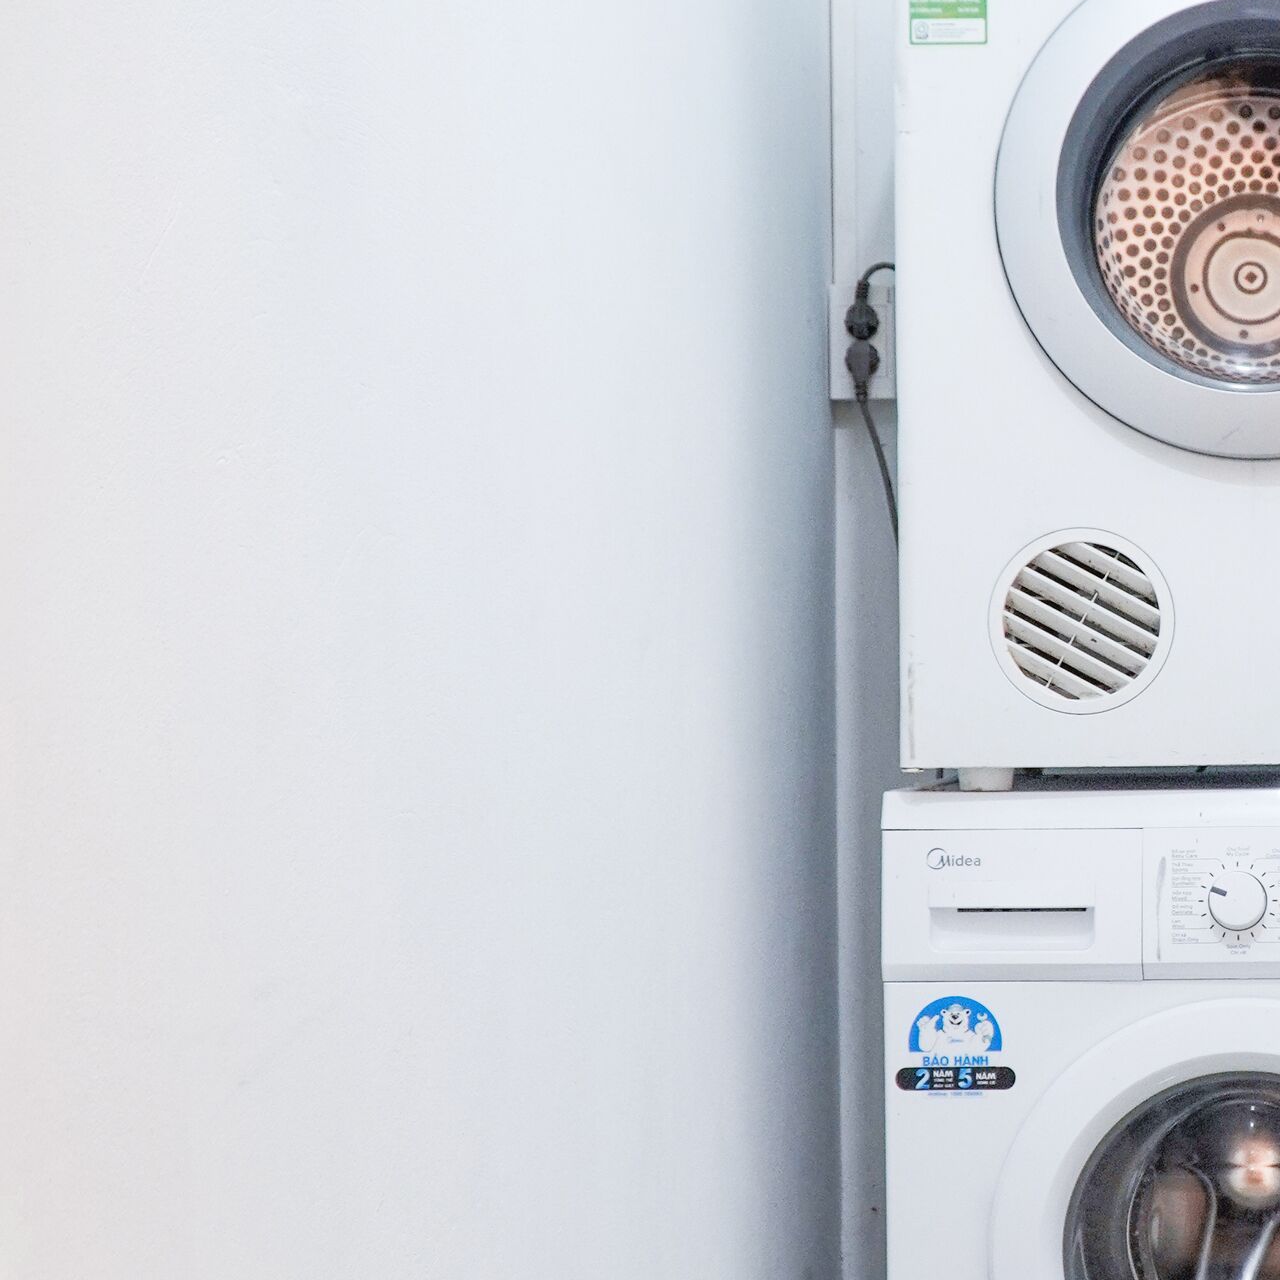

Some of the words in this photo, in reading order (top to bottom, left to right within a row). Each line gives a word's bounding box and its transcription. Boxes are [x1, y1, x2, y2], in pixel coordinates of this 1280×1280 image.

[927, 848, 982, 870] Midea
[915, 1068, 930, 1090] 2
[957, 1067, 973, 1089] 5
